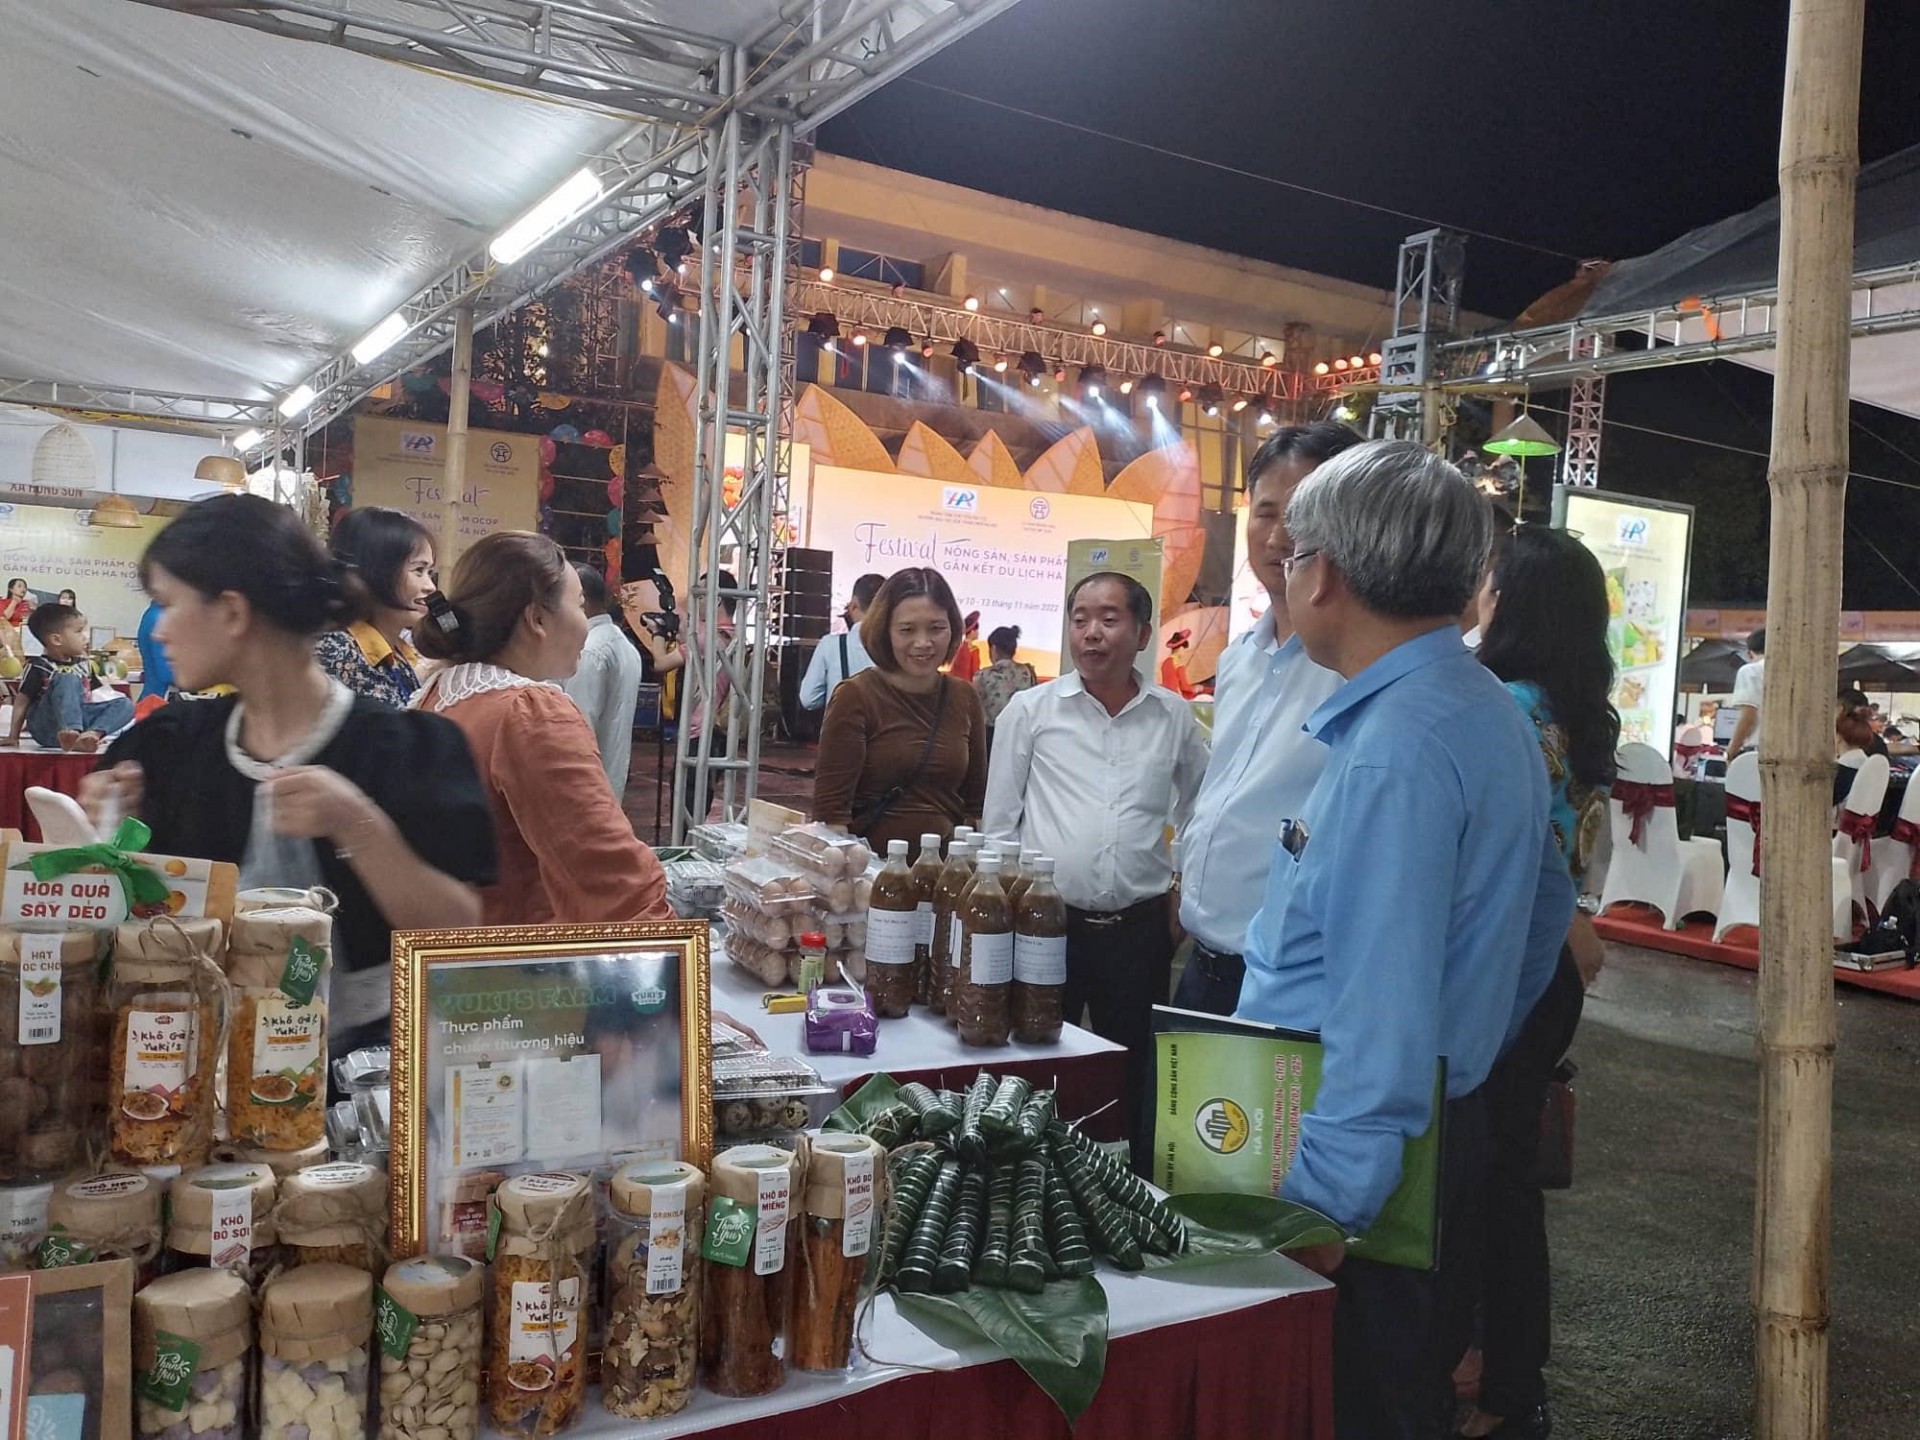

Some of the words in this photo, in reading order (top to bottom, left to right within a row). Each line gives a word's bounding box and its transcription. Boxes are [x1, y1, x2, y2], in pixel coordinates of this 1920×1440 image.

[854, 523, 938, 568] Festival
[944, 544, 979, 558] NÔNG
[1013, 551, 1036, 564] SẢN
[94, 557, 125, 568] PHẨM
[31, 564, 51, 574] KẾT
[55, 567, 71, 575] DU
[74, 567, 99, 578] LỊCH
[972, 561, 994, 575] KẾT
[998, 566, 1015, 577] DU
[1018, 567, 1044, 581] LỊCH
[981, 598, 990, 606] 13
[991, 599, 1012, 610] tháng
[1014, 601, 1023, 609] 11
[1040, 603, 1059, 612] 2022
[23, 882, 63, 896] HOA
[71, 878, 111, 898] QUẢ
[20, 900, 61, 918] SẤY
[68, 899, 107, 919] DẺO
[536, 985, 616, 1008] FARM
[270, 1015, 294, 1026] Khô
[439, 1019, 479, 1036] Thực
[483, 1013, 524, 1033] phẩm
[140, 1030, 164, 1041] Khô
[494, 1035, 550, 1052] thương
[554, 1031, 585, 1047] hiệu
[1170, 1044, 1178, 1056] NAM
[847, 1175, 861, 1185] KHÔ
[759, 1190, 776, 1200] KHÔ
[777, 1188, 788, 1198] BÒ
[848, 1184, 871, 1196] MIẾNG
[761, 1201, 786, 1212] MIẾNG
[220, 1213, 244, 1226] KHÔ
[714, 1212, 749, 1235] Thank
[213, 1227, 228, 1240] BÒ
[525, 1300, 547, 1311] Khô
[529, 1311, 564, 1321] Yuk's
